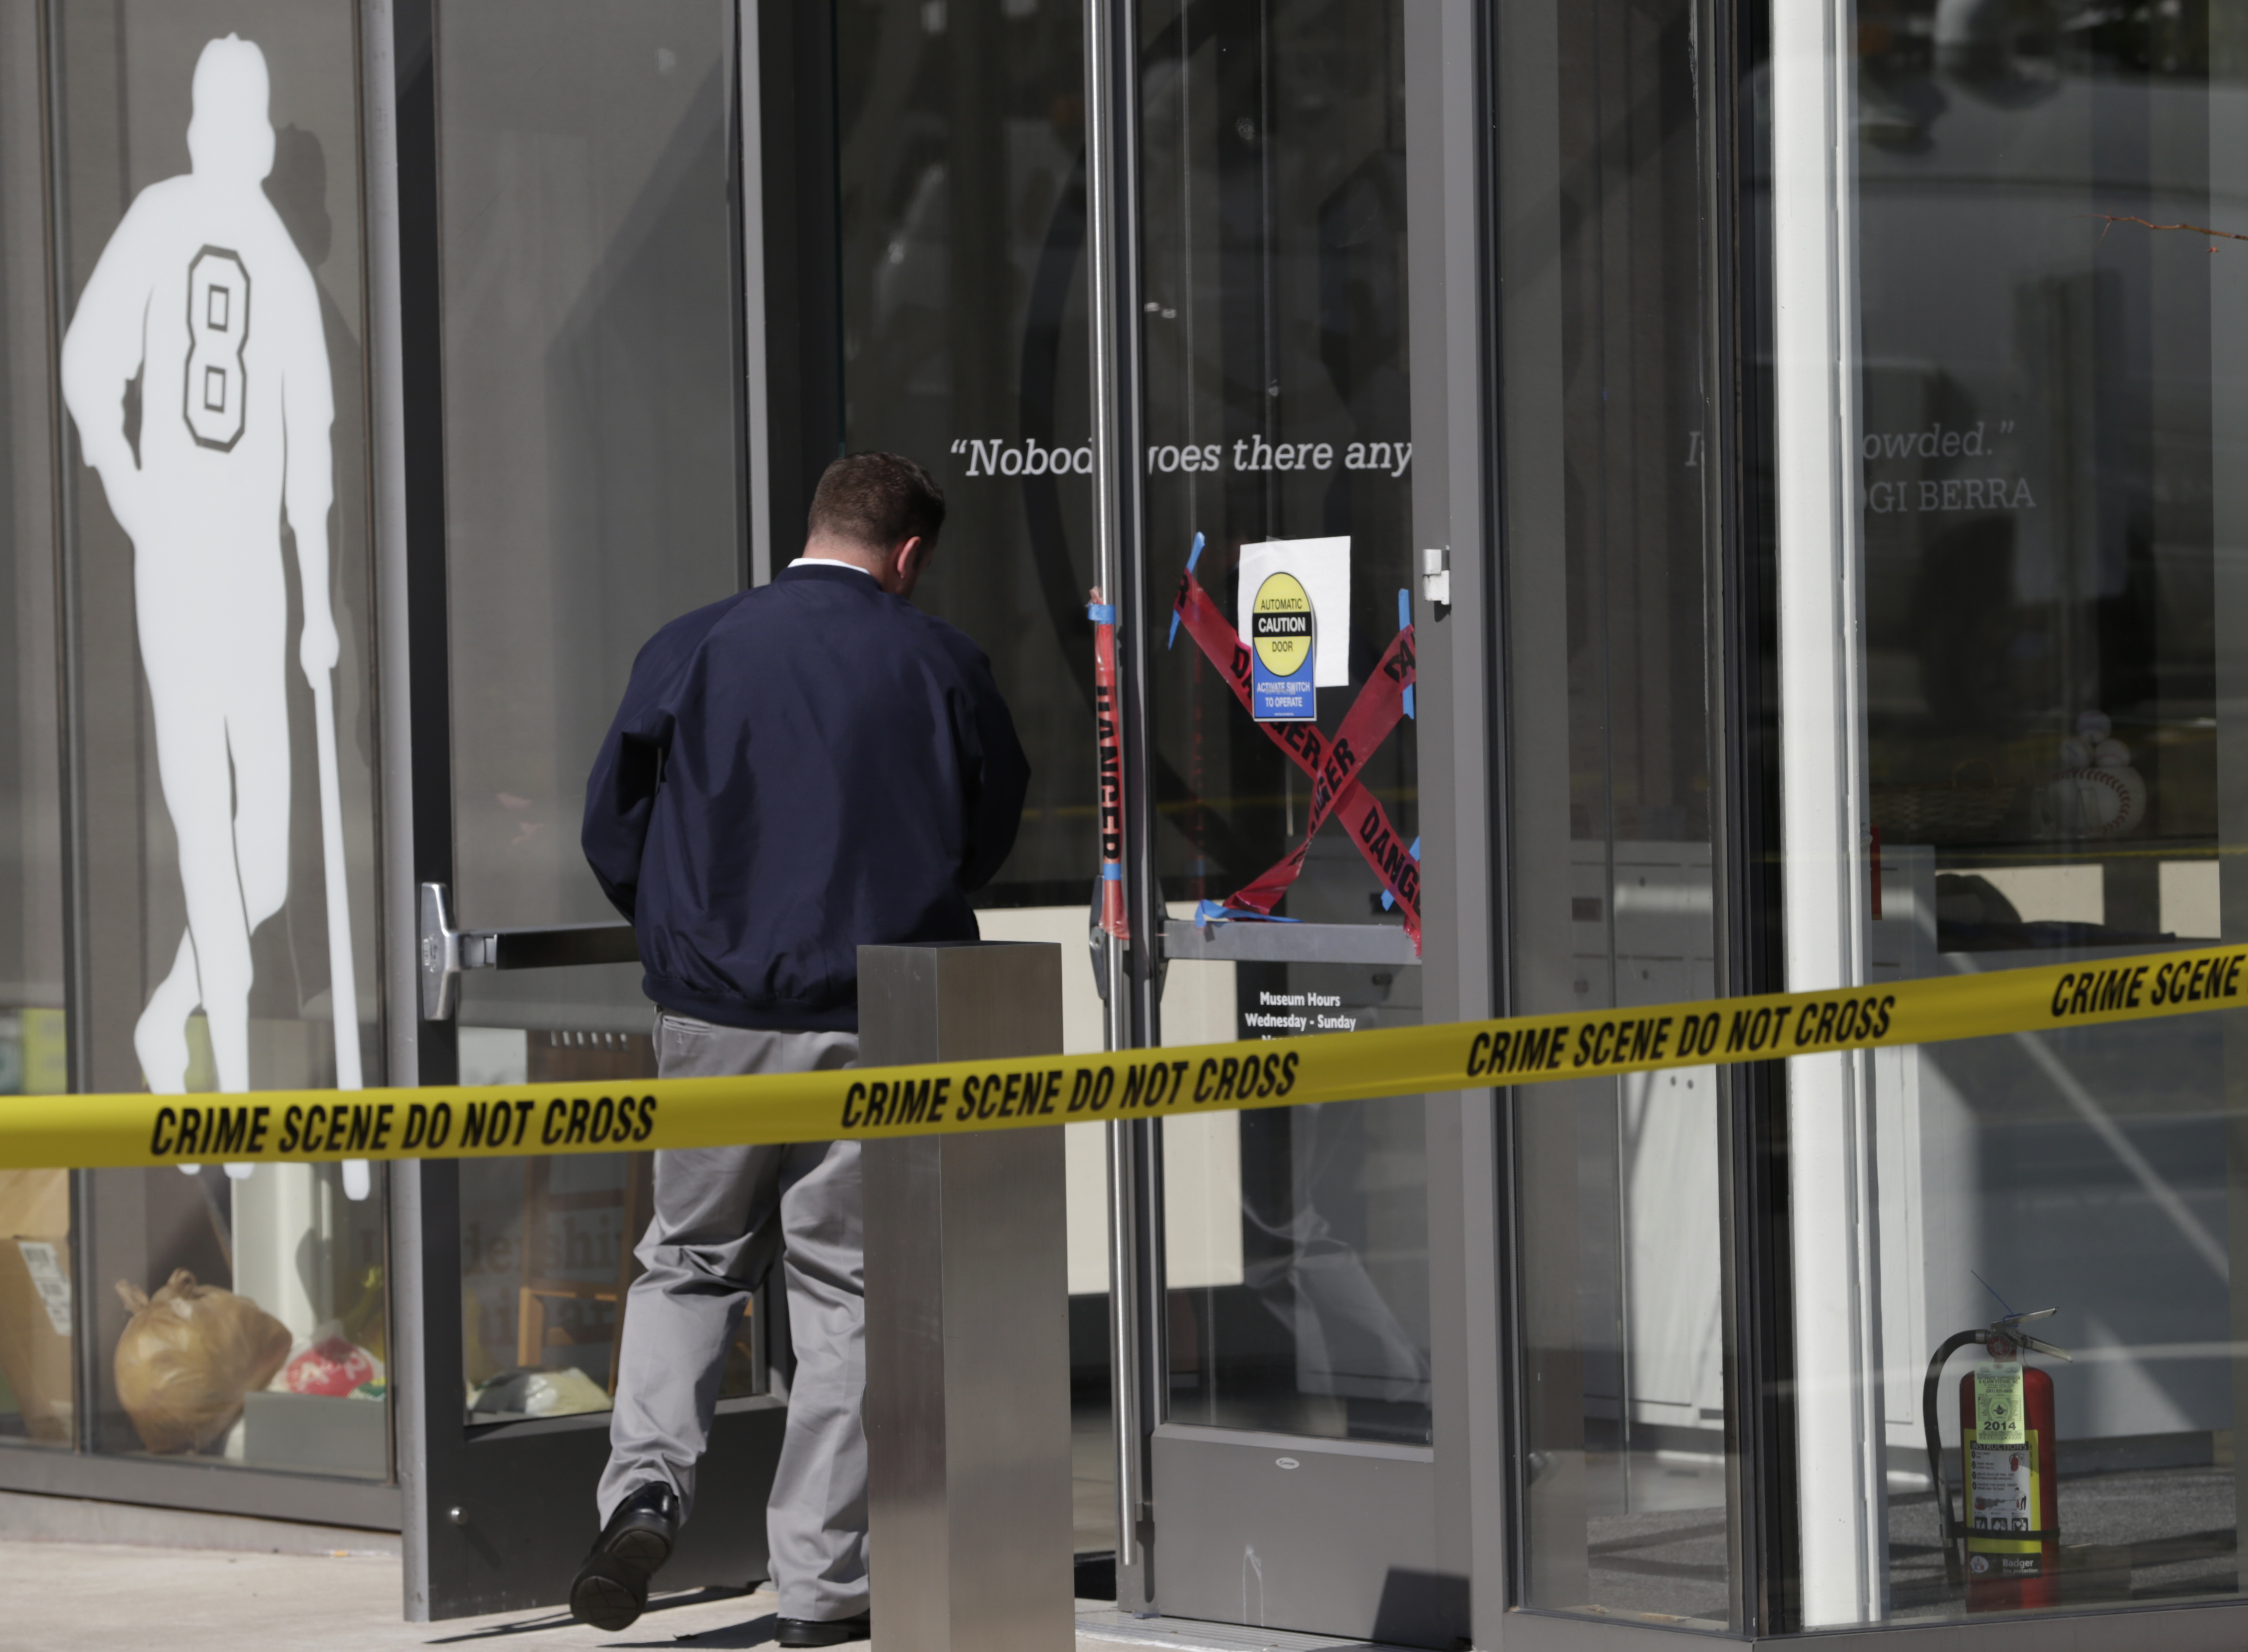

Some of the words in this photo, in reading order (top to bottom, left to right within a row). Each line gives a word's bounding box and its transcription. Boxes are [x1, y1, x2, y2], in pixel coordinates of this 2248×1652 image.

[182, 244, 251, 454] 8
[1233, 433, 1333, 471] there
[1345, 442, 1413, 477] any
[1864, 480, 1908, 514] GI
[1918, 477, 2037, 511] BERRA
[1260, 598, 1303, 610] AUTOMATIC
[1258, 616, 1306, 633] CAUTION
[1271, 641, 1293, 652] DOOR
[1256, 682, 1286, 693] ACTIVATE
[1286, 682, 1310, 692] SWITCH
[1265, 697, 1274, 707] TO
[1274, 697, 1303, 707] OPERATE
[2050, 966, 2149, 1018] CRIME
[2150, 954, 2246, 1006] SCENE
[1260, 991, 1305, 1006] Museum
[1307, 992, 1341, 1007] Hours
[1245, 1013, 1307, 1032] Wednesday
[1317, 1014, 1357, 1032] Sunday
[1467, 1025, 1570, 1077] CRIME
[1573, 1016, 1674, 1068] SCENE
[1676, 1011, 1722, 1058] DO
[1725, 1005, 1793, 1053] NOT
[1794, 995, 1896, 1047] CROSS
[841, 1077, 951, 1129] CRIME
[955, 1070, 1063, 1122] SCENE
[1066, 1065, 1115, 1113] DO
[1119, 1060, 1189, 1109] NOT
[1193, 1051, 1300, 1104] CROSS
[150, 1107, 270, 1157] CRIME
[278, 1104, 394, 1154] SCENE
[400, 1102, 452, 1150] DO
[459, 1100, 535, 1149] NOT
[541, 1095, 657, 1146] CROSS
[1983, 1421, 2016, 1431] 2014
[1972, 1442, 2027, 1450] INSTRUCTIONS
[2003, 1559, 2034, 1569] Badger
